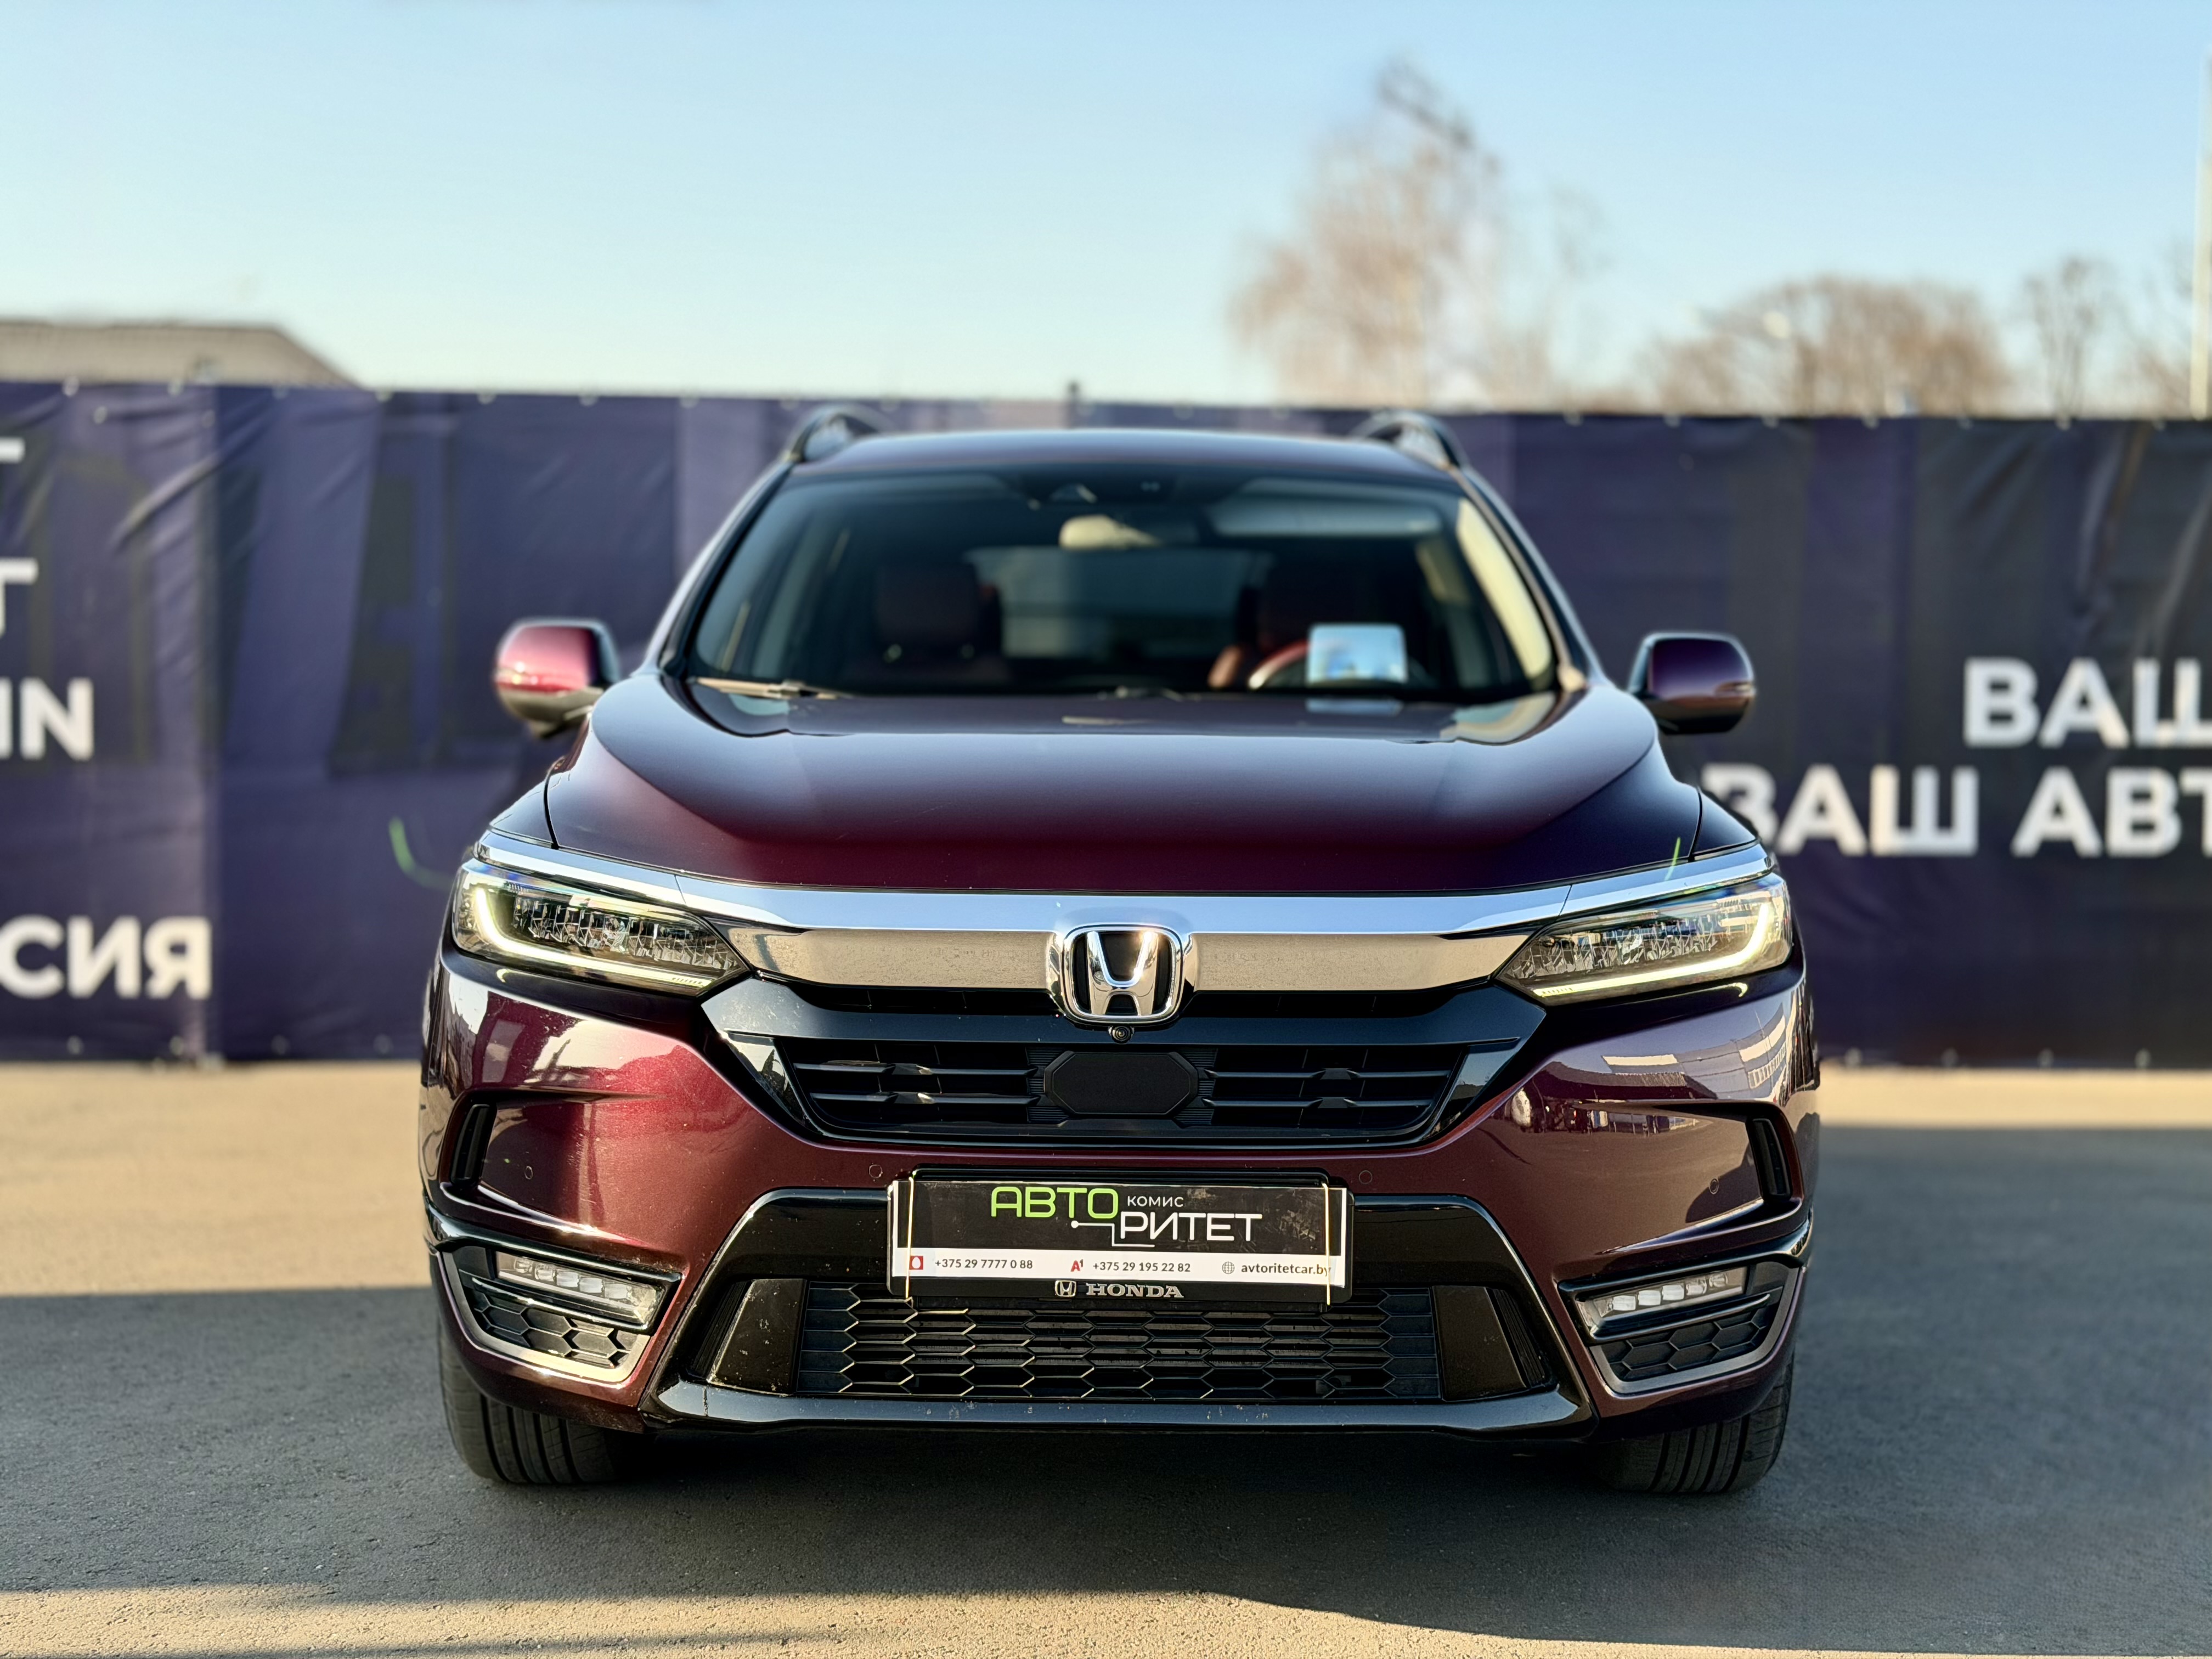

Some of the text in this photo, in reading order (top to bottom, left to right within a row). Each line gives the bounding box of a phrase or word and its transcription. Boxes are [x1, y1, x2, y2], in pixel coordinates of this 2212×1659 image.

[0, 915, 212, 1000] СИЯ
[991, 1186, 1119, 1219] АВТО
[1127, 1195, 1184, 1207] КОМИС
[1120, 1211, 1263, 1242] РИТЕТ
[935, 1259, 1033, 1269] +375 29 7777 0 88
[1093, 1261, 1190, 1272] +375 29 195 22 82
[1241, 1263, 1331, 1277] avtoritetcar.by
[1086, 1283, 1184, 1298] HONDA
